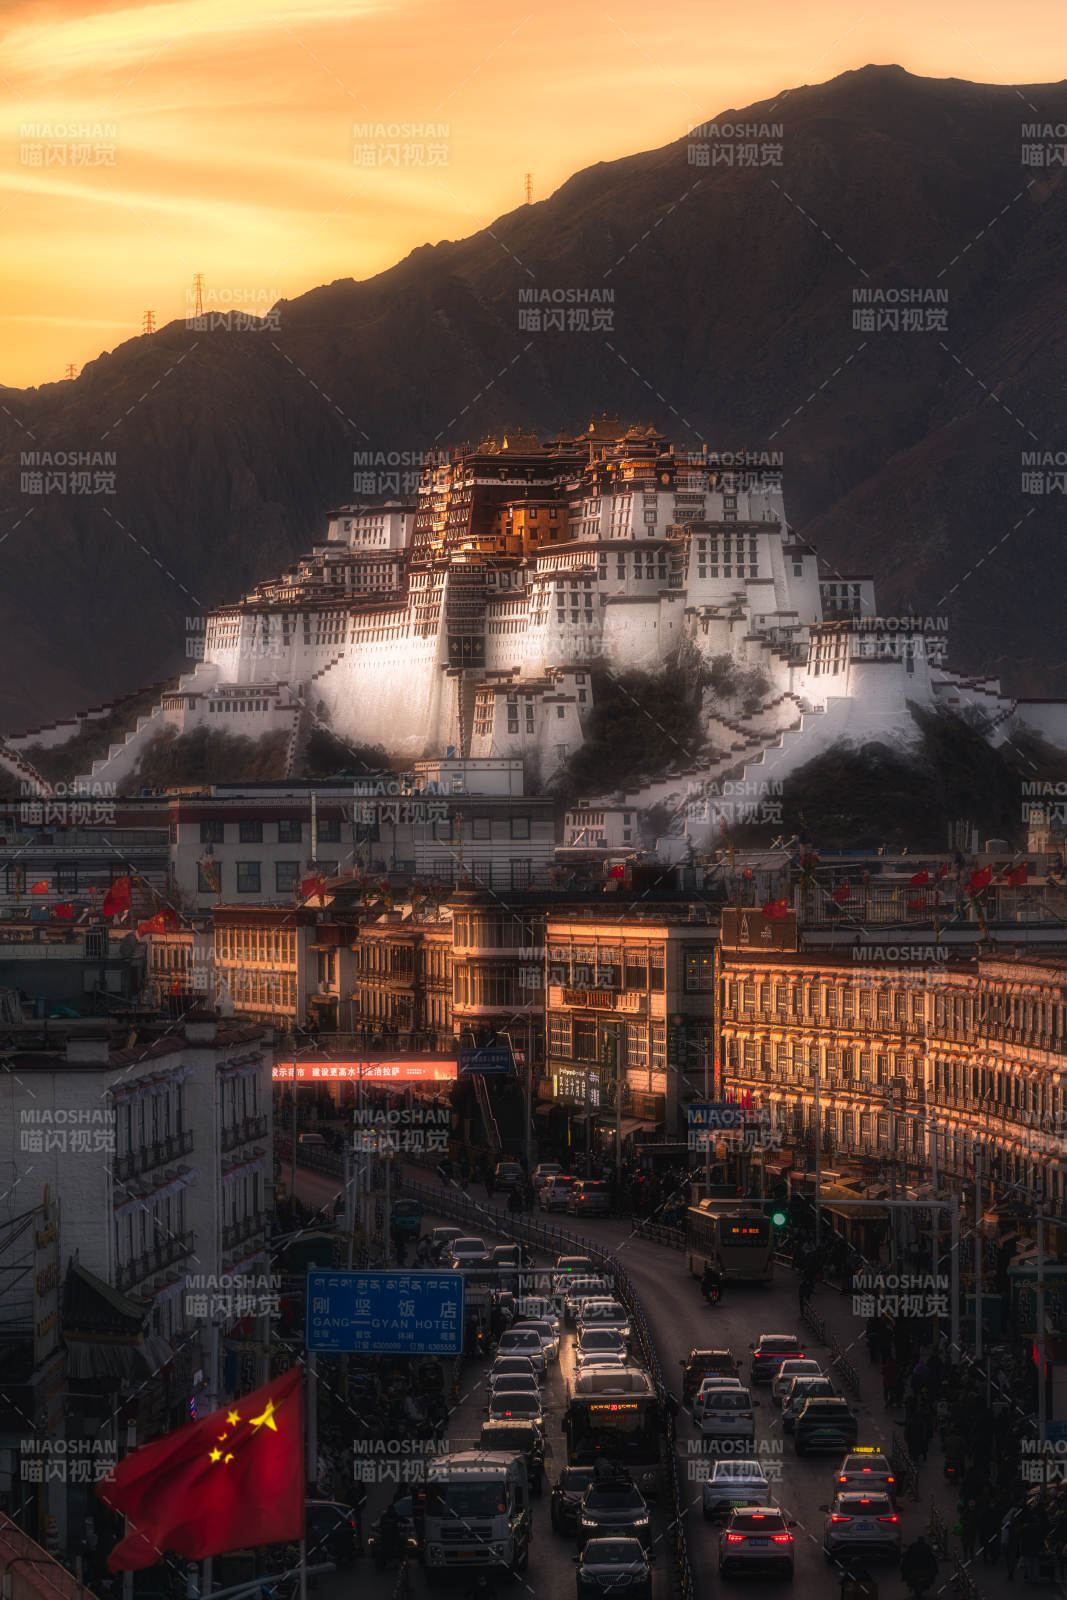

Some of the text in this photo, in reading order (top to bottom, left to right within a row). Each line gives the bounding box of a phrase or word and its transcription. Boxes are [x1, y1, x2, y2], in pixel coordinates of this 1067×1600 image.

[313, 1296, 457, 1319] 刚坚饭店
[415, 1320, 457, 1330] HOTEL
